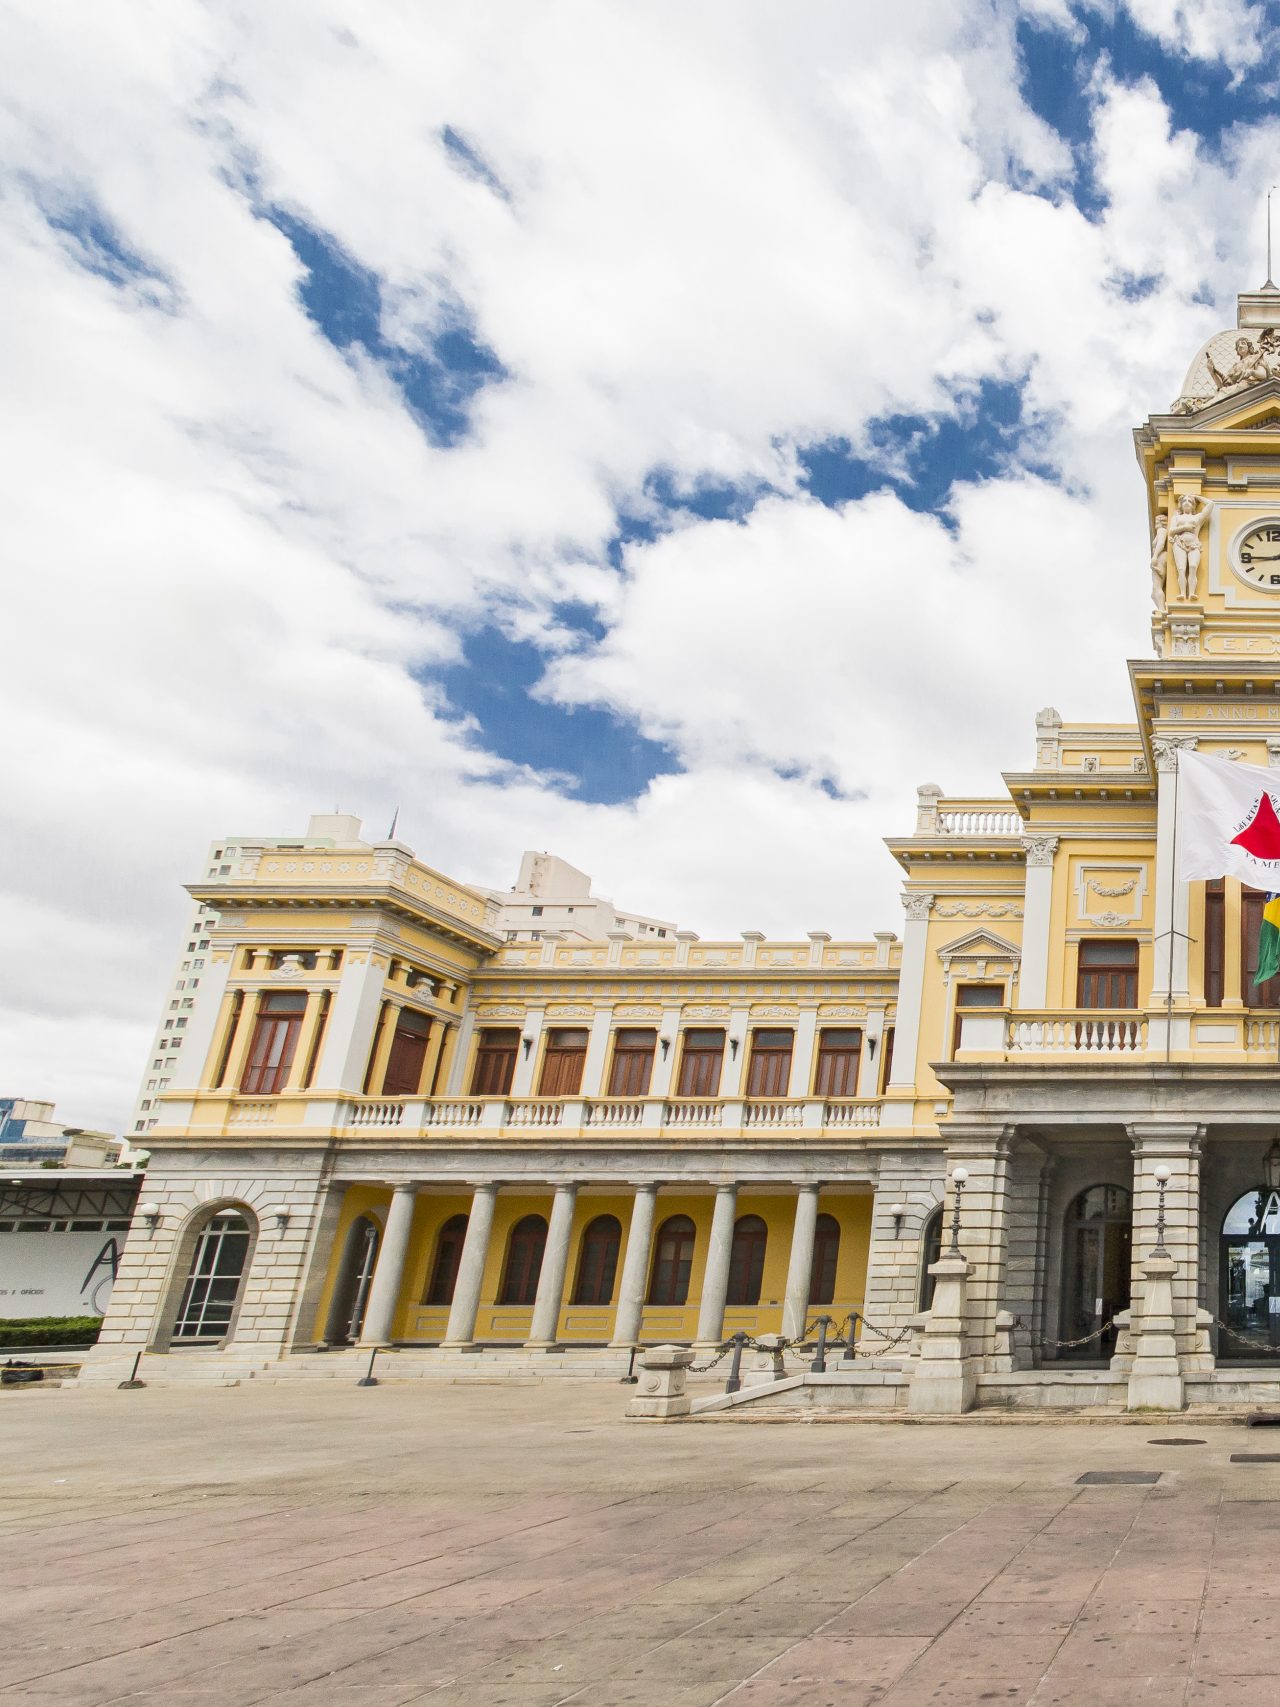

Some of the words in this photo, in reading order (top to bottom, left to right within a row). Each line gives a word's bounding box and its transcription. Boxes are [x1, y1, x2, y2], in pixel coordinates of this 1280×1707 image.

[1241, 552, 1252, 564] 9
[1270, 574, 1280, 585] 6
[1204, 706, 1257, 719] ANNO
